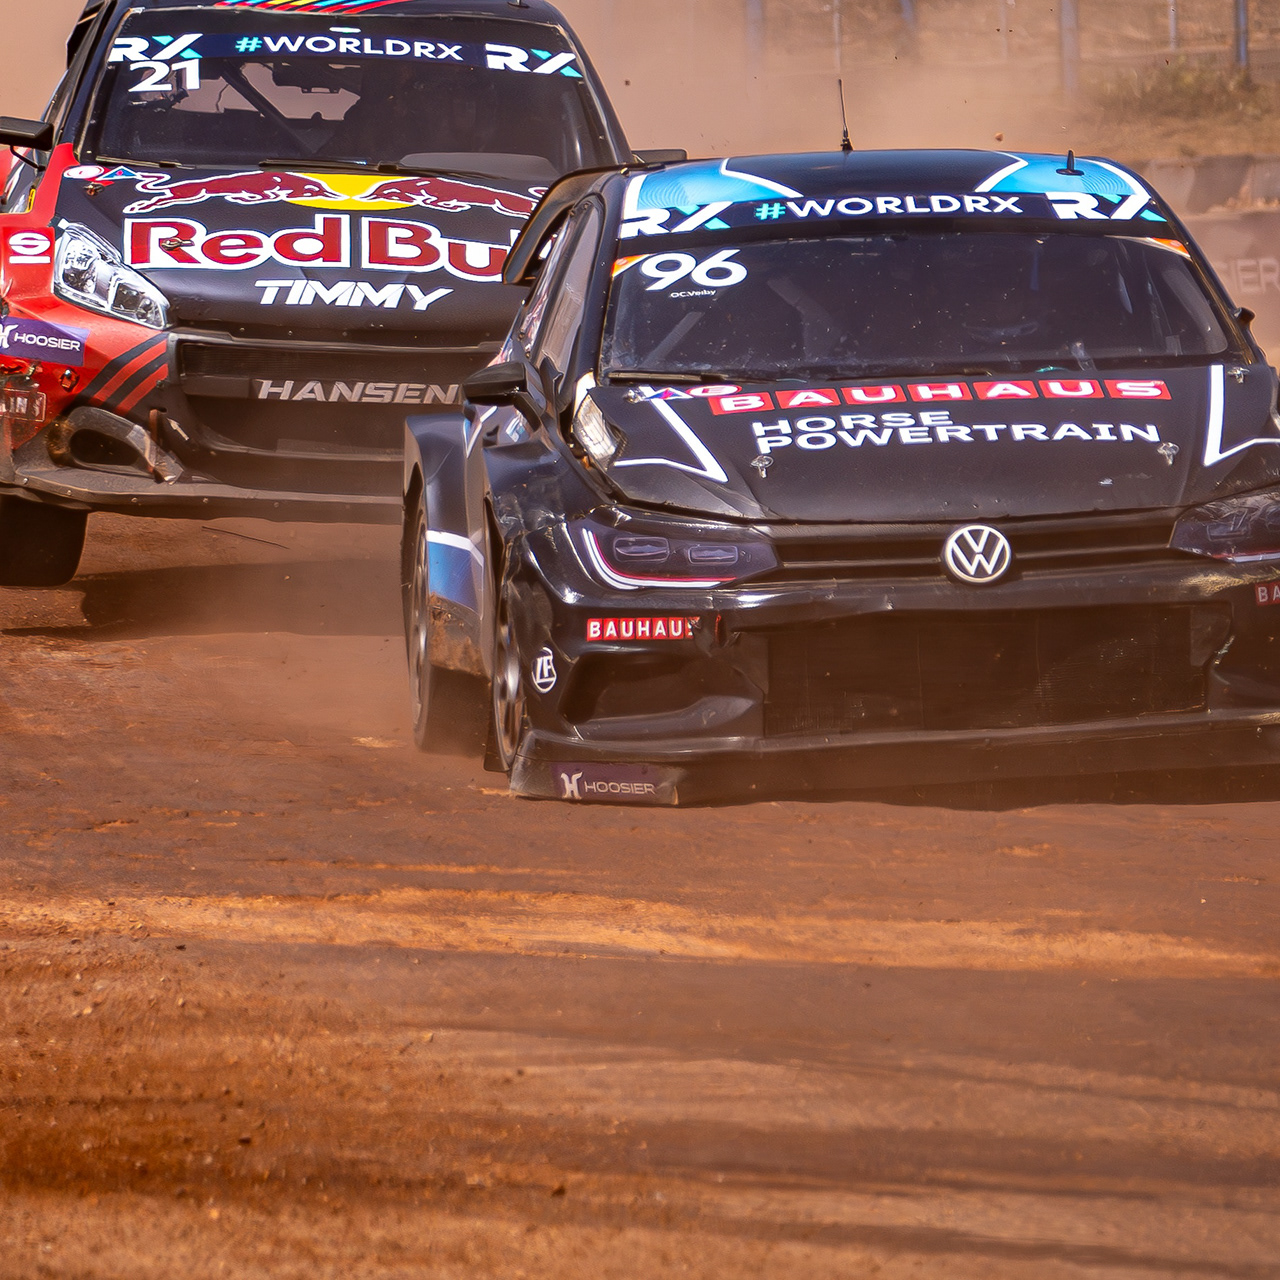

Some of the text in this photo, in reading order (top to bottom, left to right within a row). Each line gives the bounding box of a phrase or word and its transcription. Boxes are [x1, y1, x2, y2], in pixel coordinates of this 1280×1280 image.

[109, 33, 583, 77] RX #WORLDRX RX
[128, 60, 201, 92] 21
[620, 191, 1167, 239] RX #WORLDRX RX
[123, 214, 520, 282] Red Bu
[641, 249, 748, 291] 96
[254, 280, 455, 311] TIMMY
[14, 332, 80, 351] HOOSIER
[257, 379, 462, 405] HANSEN
[721, 380, 1164, 411] BAUHAUS
[751, 411, 954, 436] HORSE
[757, 423, 1161, 454] POWERTRAIN
[584, 780, 656, 796] HOOSIER
